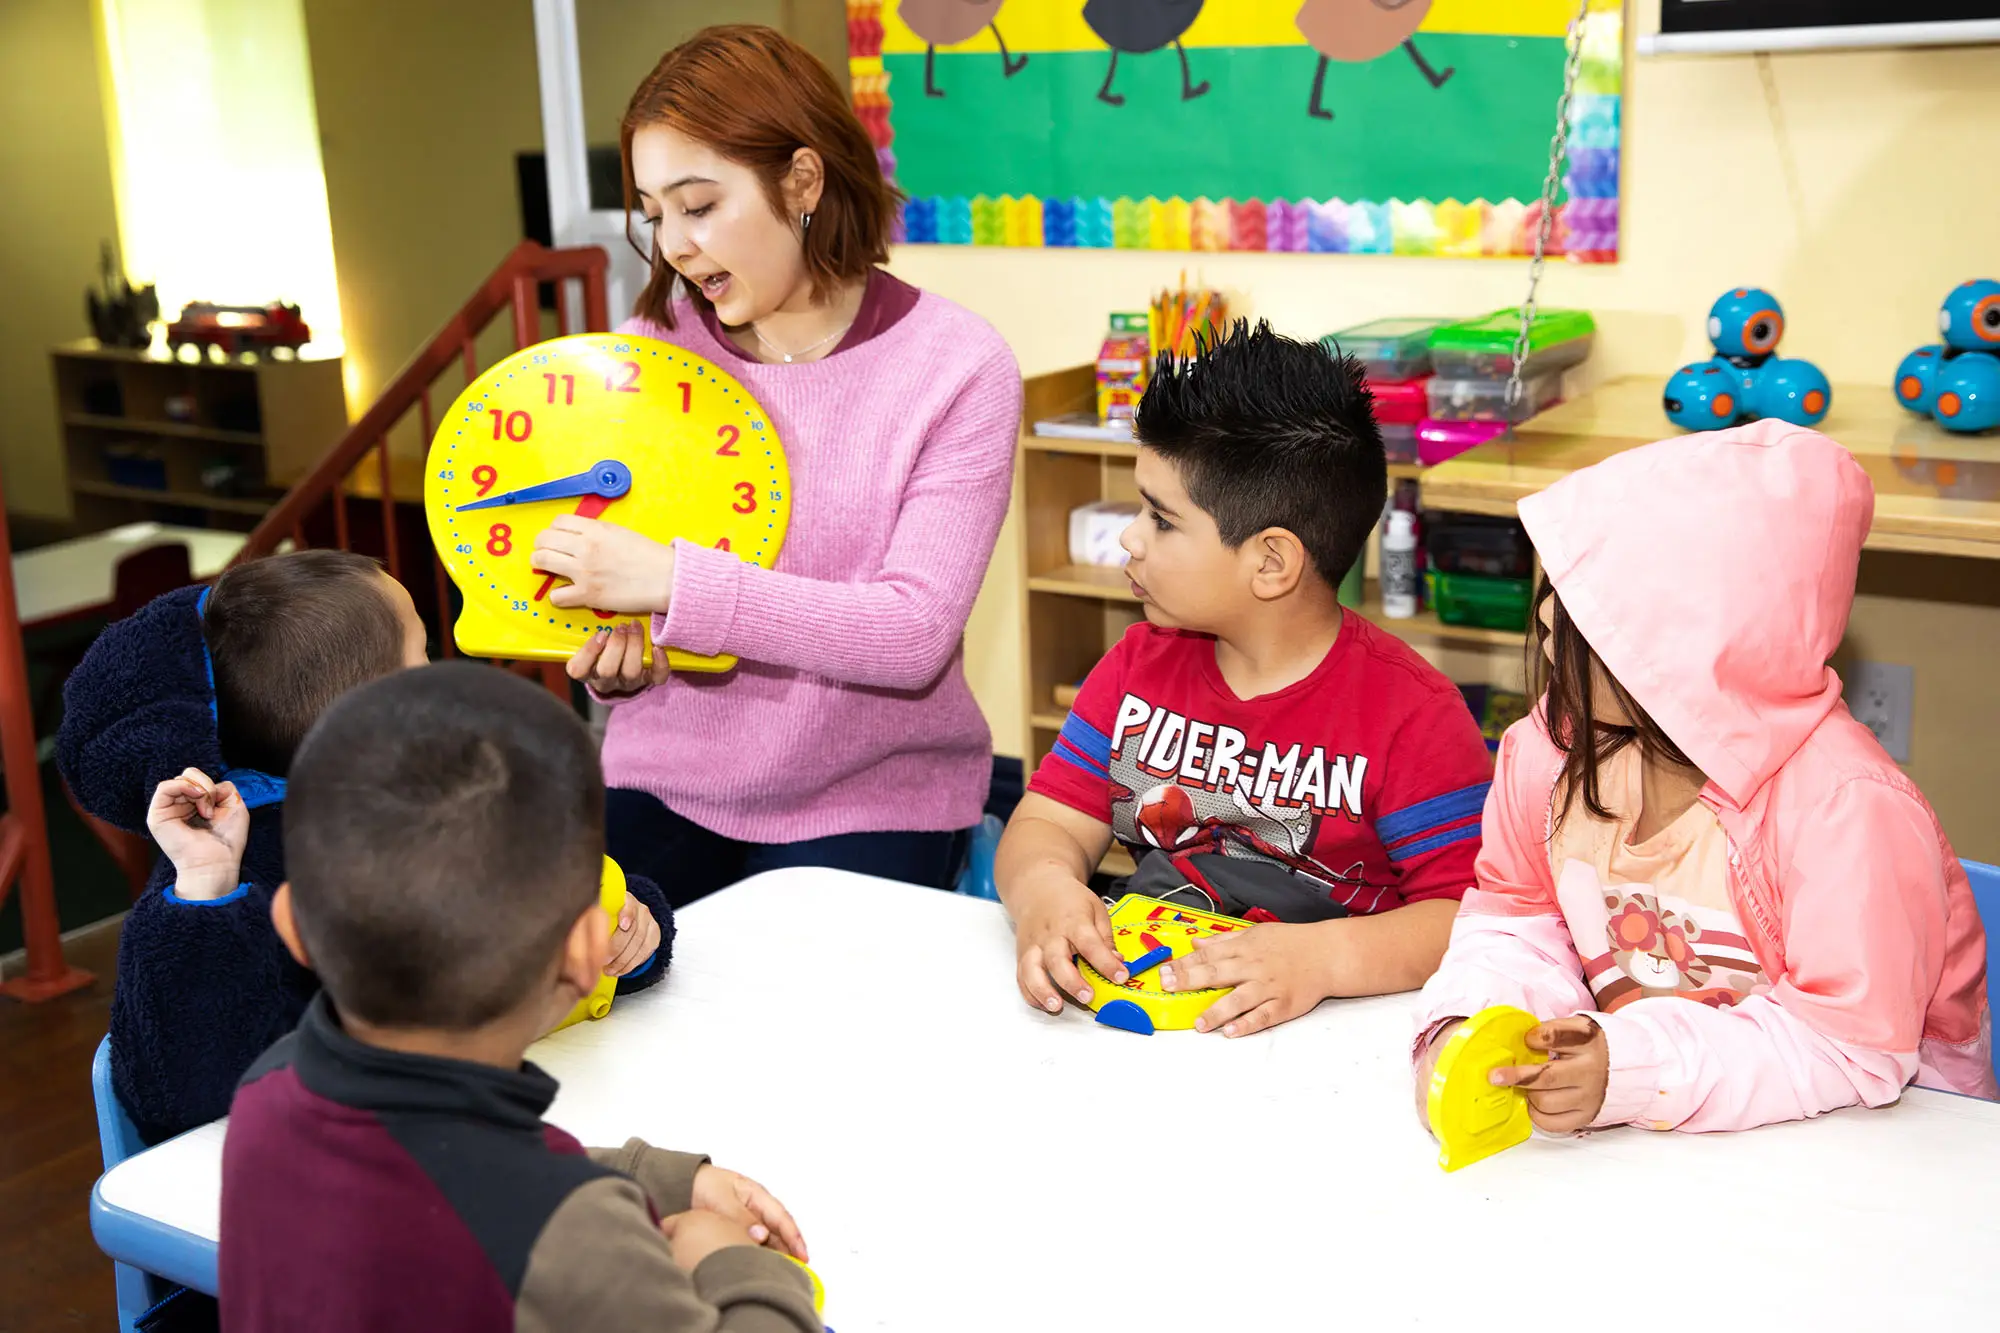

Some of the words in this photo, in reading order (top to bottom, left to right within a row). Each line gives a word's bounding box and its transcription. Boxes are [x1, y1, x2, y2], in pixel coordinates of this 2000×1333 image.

[614, 344, 630, 353] 60
[532, 355, 548, 365] 55
[697, 366, 705, 376] 5
[543, 373, 575, 405] 11
[677, 382, 692, 413] 1
[468, 402, 484, 412] 50
[489, 409, 533, 442] 10
[751, 420, 764, 431] 10
[716, 425, 740, 456] 2
[438, 470, 455, 481] 45
[471, 465, 498, 497] 9
[732, 482, 757, 514] 3
[769, 491, 782, 502] 15
[486, 523, 513, 557] 8
[456, 543, 472, 555] 40
[511, 601, 529, 612] 35
